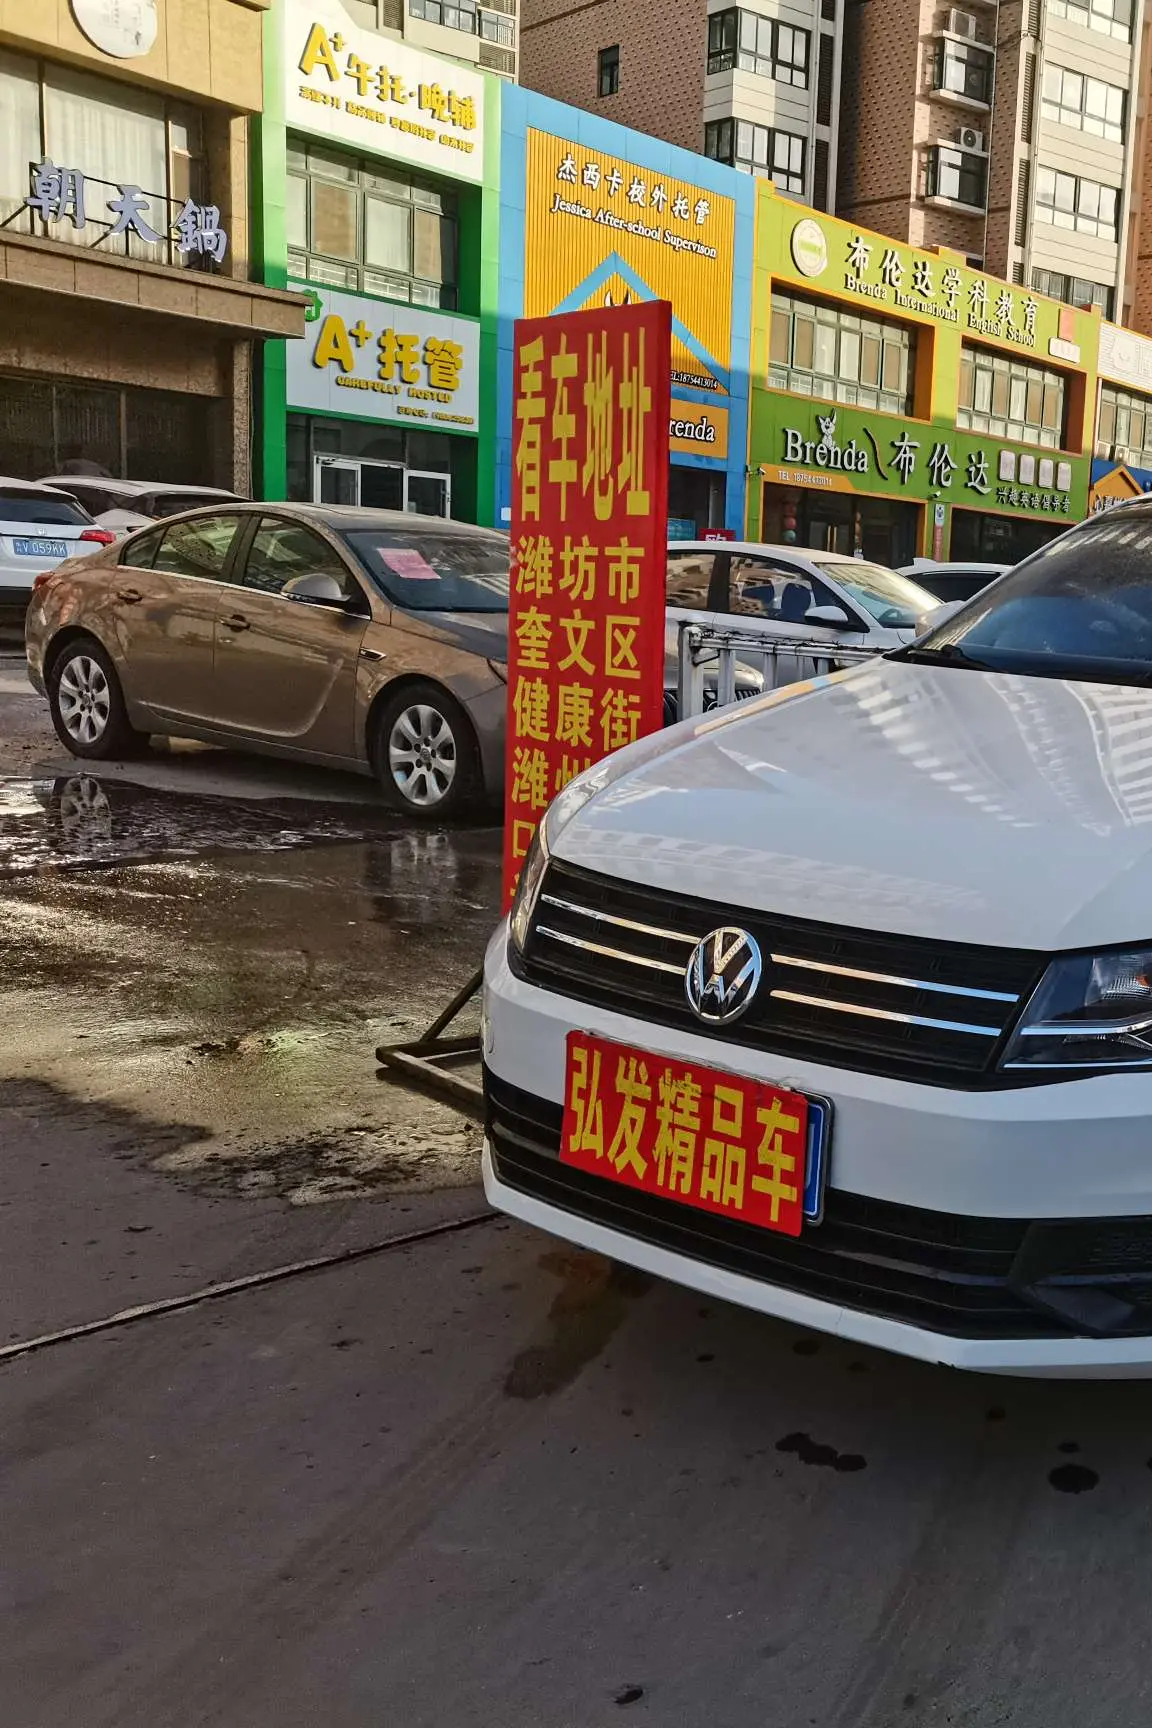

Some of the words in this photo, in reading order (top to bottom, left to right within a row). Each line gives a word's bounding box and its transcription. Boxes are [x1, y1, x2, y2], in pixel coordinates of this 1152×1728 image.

[24, 157, 228, 263] 朝天鍋
[551, 193, 592, 219] Jessica
[595, 208, 662, 242] After-school
[663, 231, 717, 259] Supervison
[557, 153, 712, 225] 杰西卡校外托管
[845, 236, 1040, 335] 布伦达学科教育
[845, 273, 888, 300] Brenda
[895, 290, 961, 323] International
[967, 312, 1003, 338] English
[1006, 324, 1036, 348] School
[516, 326, 652, 521] 看车地址
[669, 417, 715, 442] renda
[783, 427, 869, 473] Brenda
[888, 431, 992, 495] 布伦达
[515, 535, 645, 604] 潍坊市
[514, 606, 642, 680] 奎文区
[512, 675, 641, 752] 健康街
[569, 1046, 800, 1224] 弘发精品车
